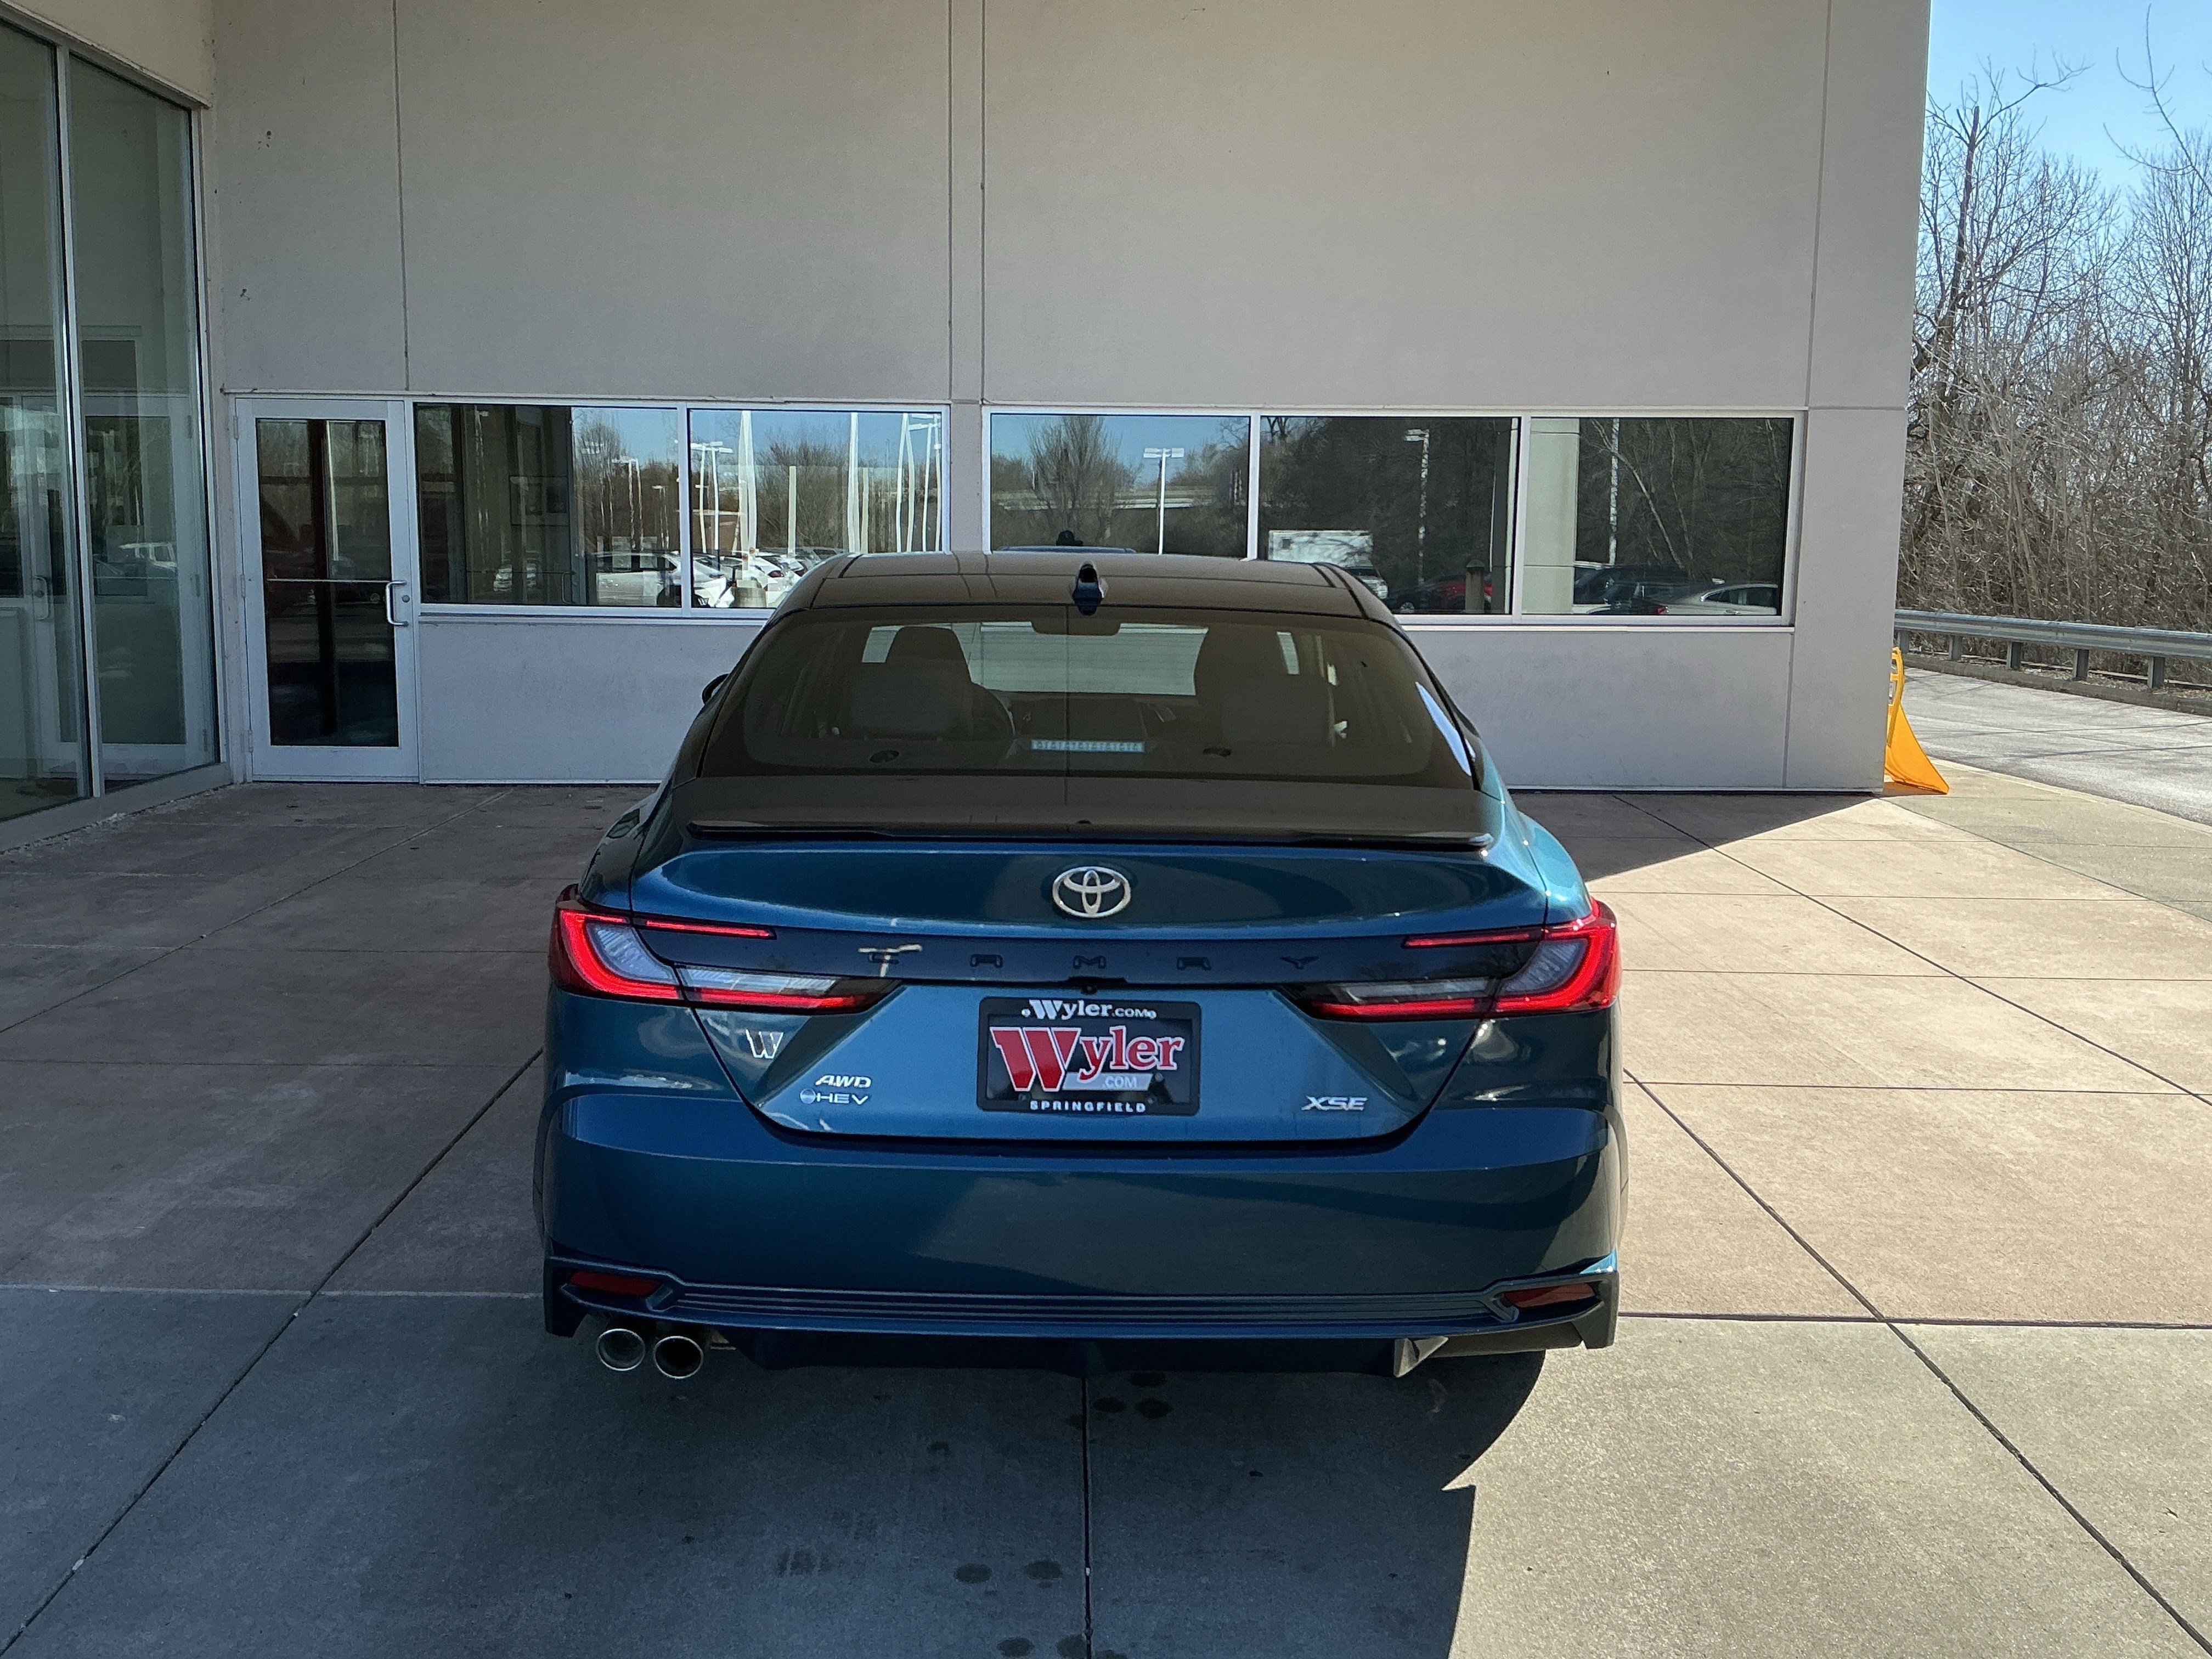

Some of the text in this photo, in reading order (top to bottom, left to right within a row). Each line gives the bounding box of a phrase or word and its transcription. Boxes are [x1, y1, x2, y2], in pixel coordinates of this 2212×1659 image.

[989, 1025, 1185, 1092] Wyler
[815, 1074, 872, 1088] AWD
[1029, 1100, 1147, 1113] SPRINGFIELD
[1301, 1095, 1368, 1111] XSE
